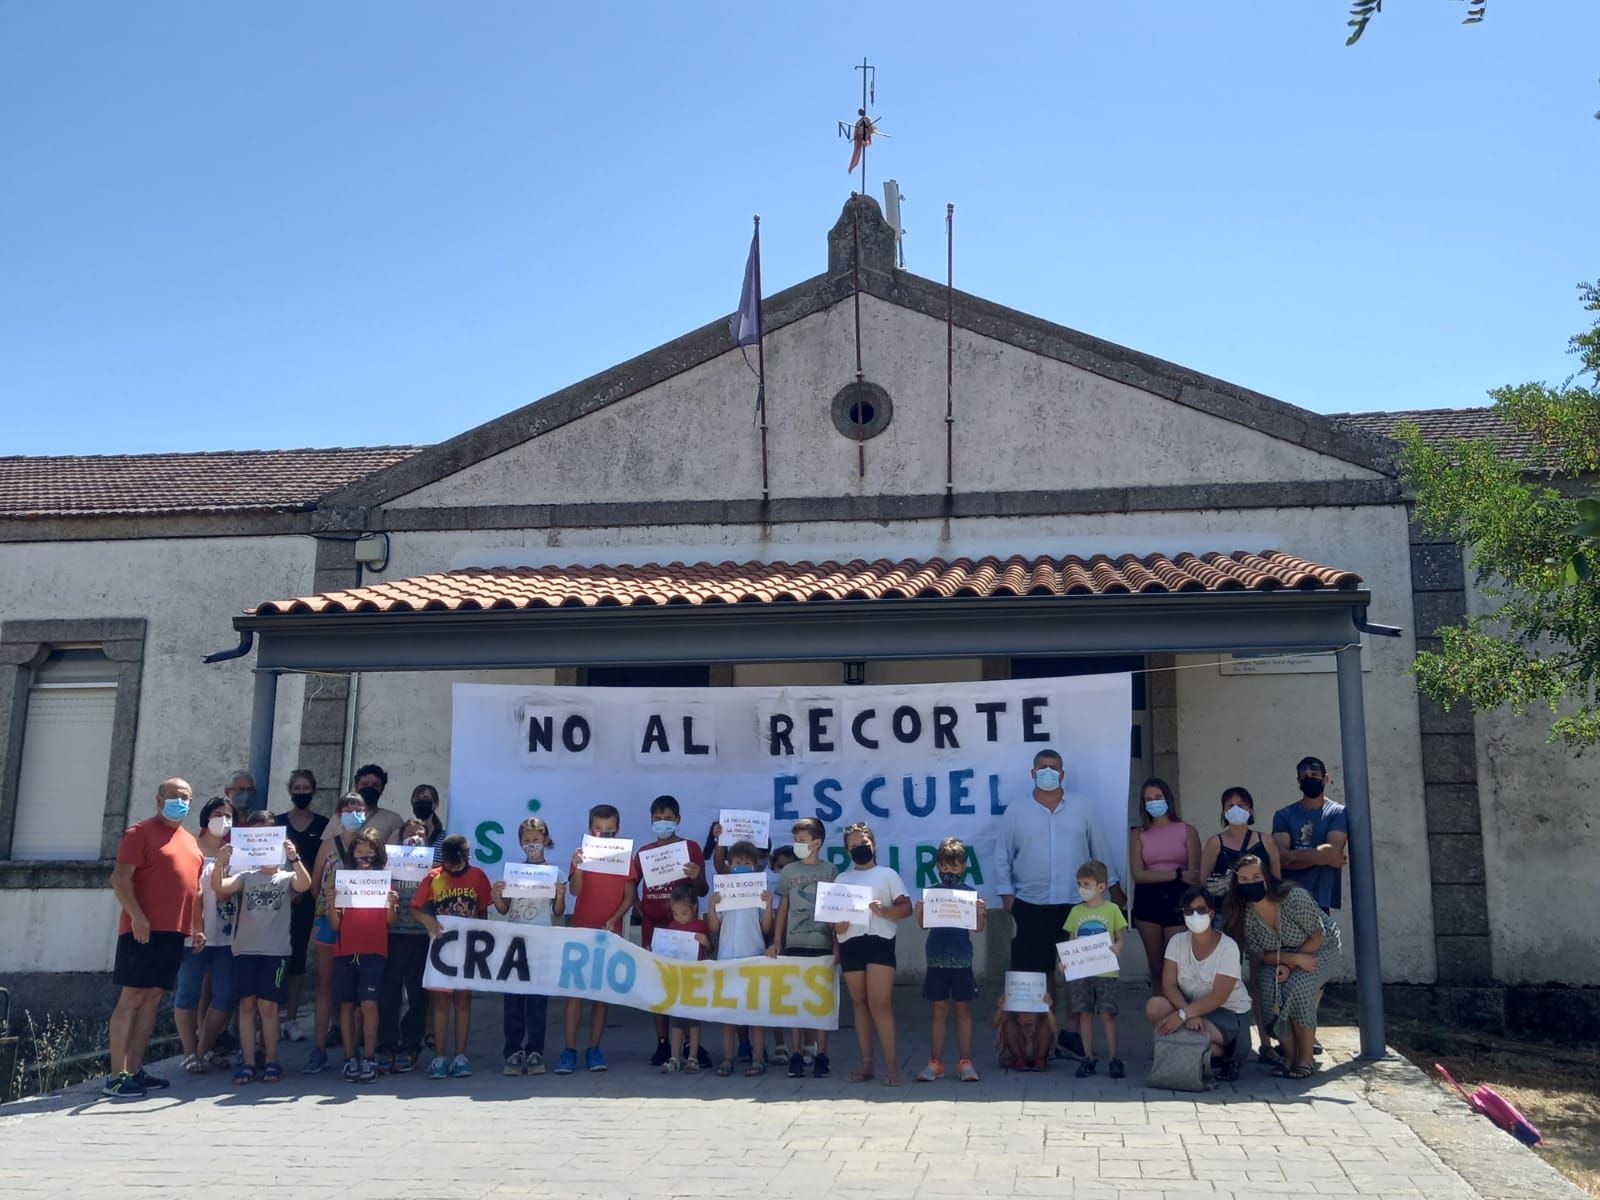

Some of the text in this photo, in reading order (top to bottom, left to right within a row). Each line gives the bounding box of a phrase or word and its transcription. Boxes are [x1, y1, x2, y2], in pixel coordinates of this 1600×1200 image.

[529, 697, 1050, 756] NO AL RECORTE
[773, 768, 1008, 822] ESCUEL
[430, 929, 531, 982] CRA
[648, 958, 835, 1017] YELTES
